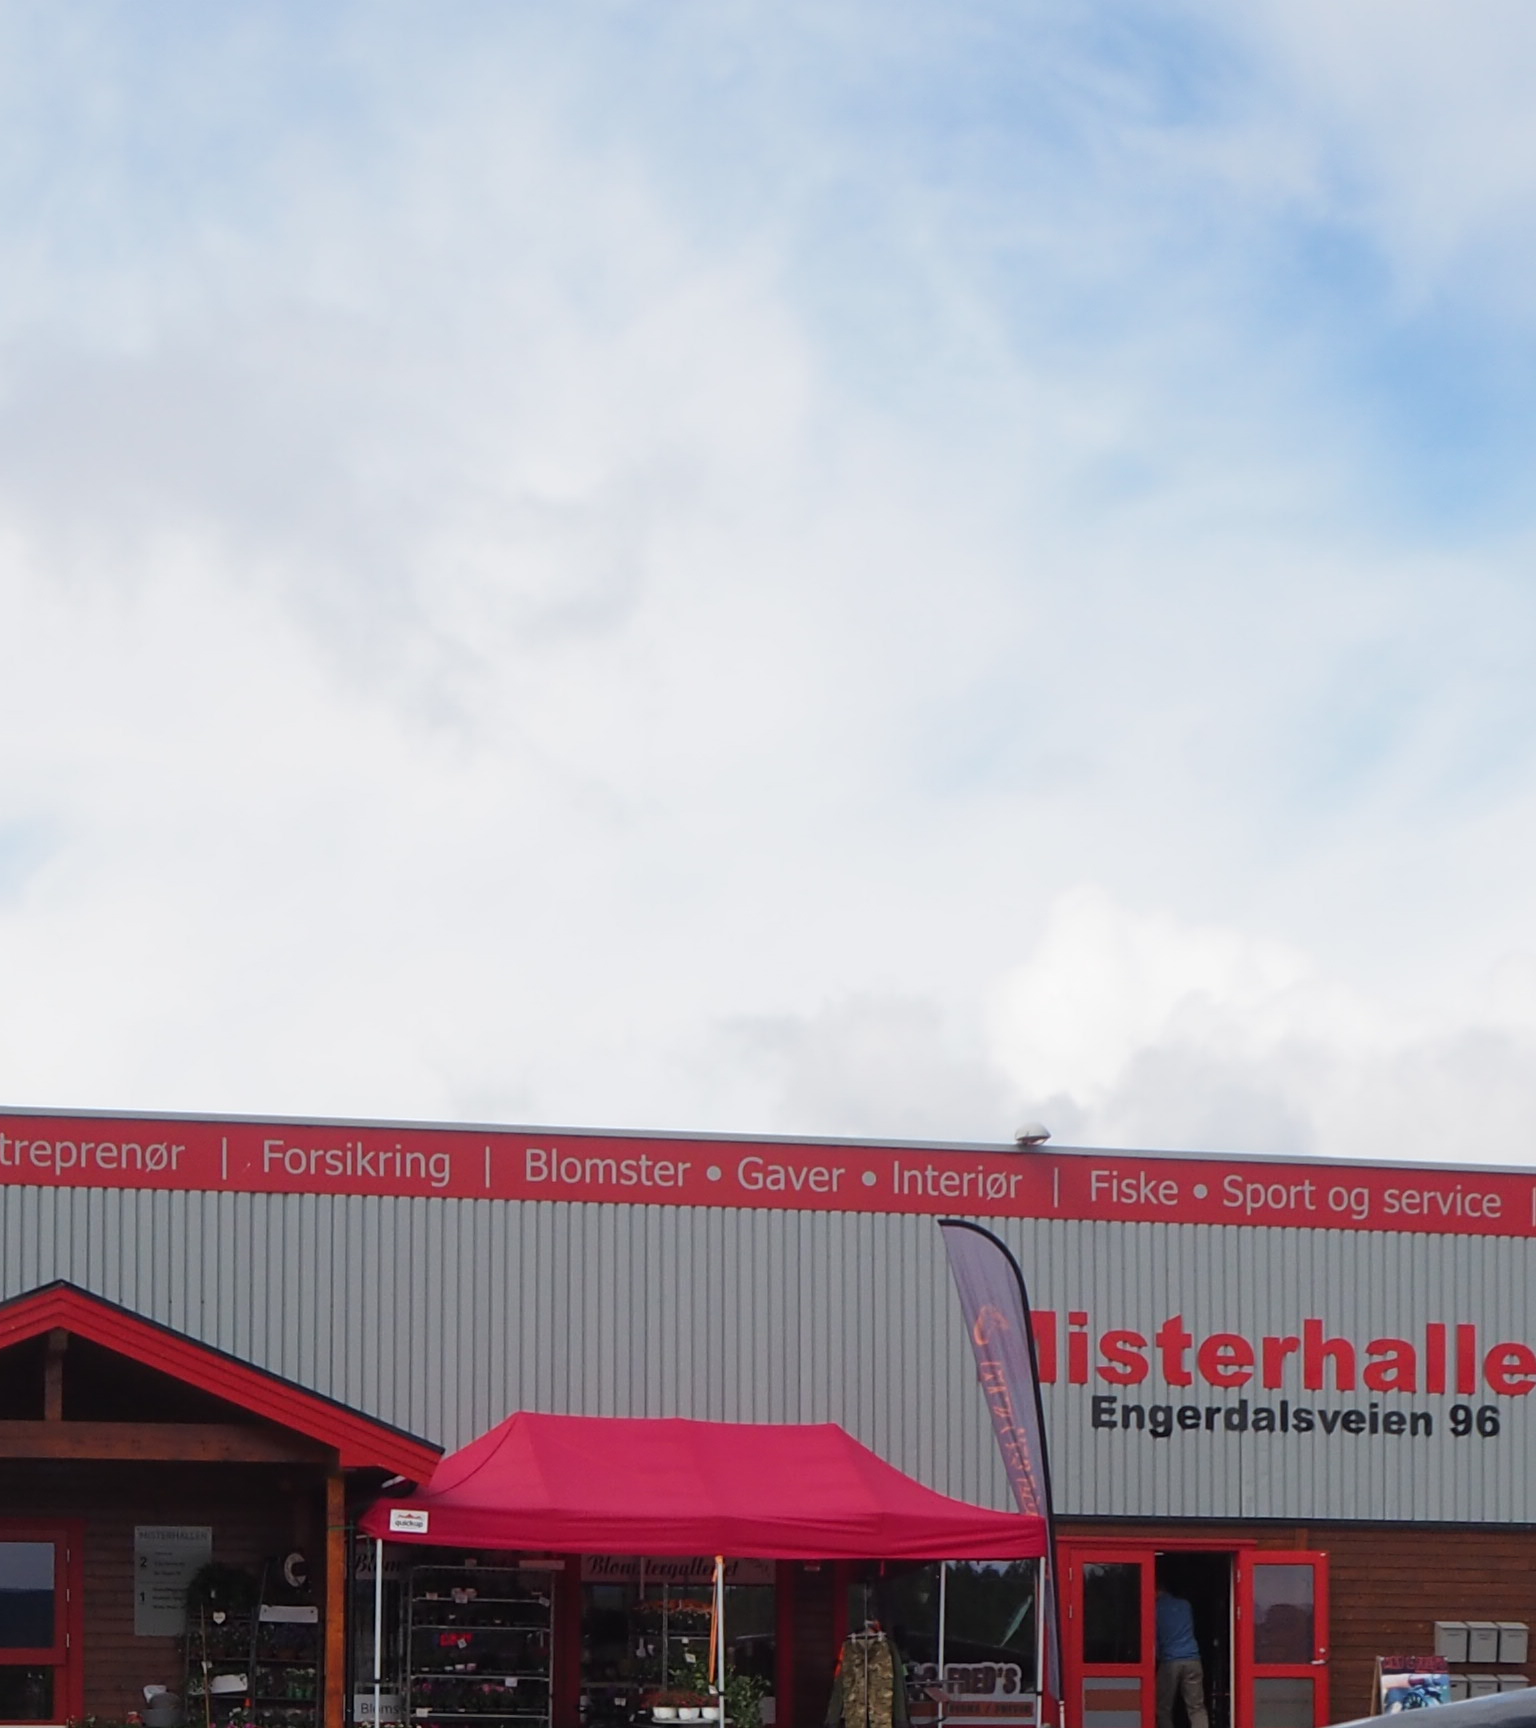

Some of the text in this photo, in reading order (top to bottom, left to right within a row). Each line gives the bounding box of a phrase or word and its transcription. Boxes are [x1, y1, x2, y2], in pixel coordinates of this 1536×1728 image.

[263, 1139, 451, 1187] Forsikring
[525, 1147, 692, 1187] Blomster
[737, 1156, 846, 1193] Gaver
[893, 1160, 1023, 1200] Interiør
[1090, 1169, 1179, 1205] Fiske
[1222, 1174, 1316, 1216] Sport
[1328, 1184, 1370, 1220] og
[1383, 1185, 1502, 1218] service
[1091, 1395, 1501, 1438] Engerdalsveien 96
